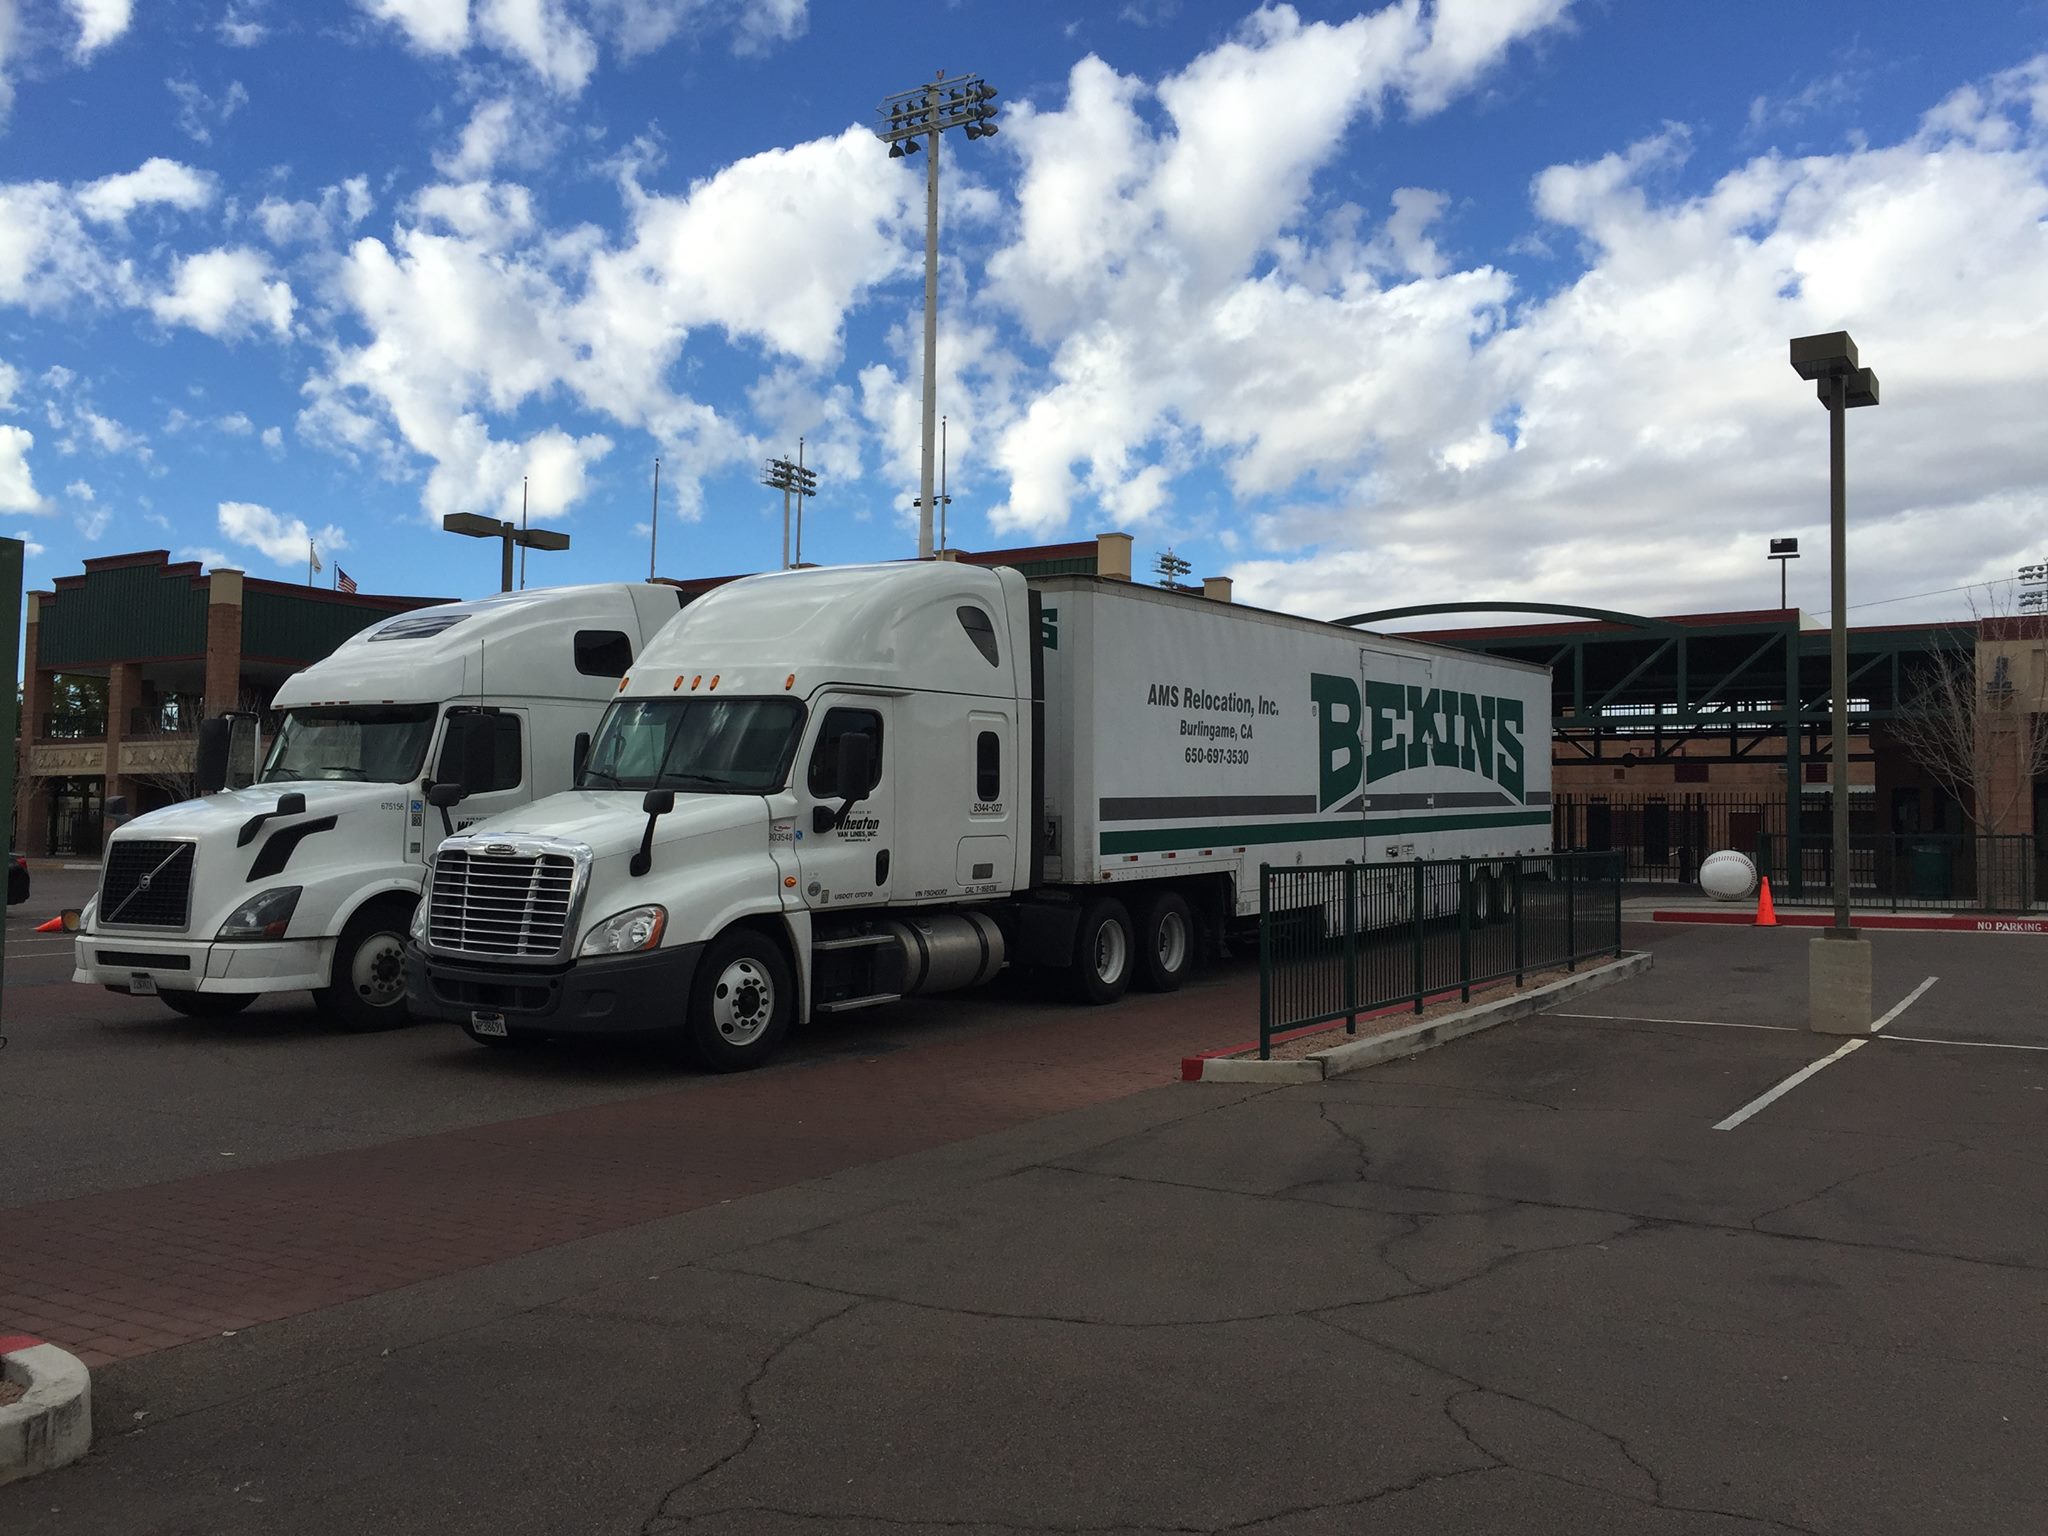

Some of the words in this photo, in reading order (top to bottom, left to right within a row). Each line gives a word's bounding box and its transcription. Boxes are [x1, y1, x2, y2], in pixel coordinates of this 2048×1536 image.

[1147, 683, 1180, 708] AMS
[1183, 687, 1255, 718] Relocation,
[1258, 695, 1280, 716] Inc.
[1179, 719, 1238, 741] Burlingame,
[1240, 723, 1254, 739] CA
[1311, 672, 1525, 813] BEKINS
[1184, 747, 1250, 764] 650-697-3530
[380, 802, 405, 811] 675156
[1977, 921, 1992, 930] NO
[1995, 921, 2042, 931] PARKING
